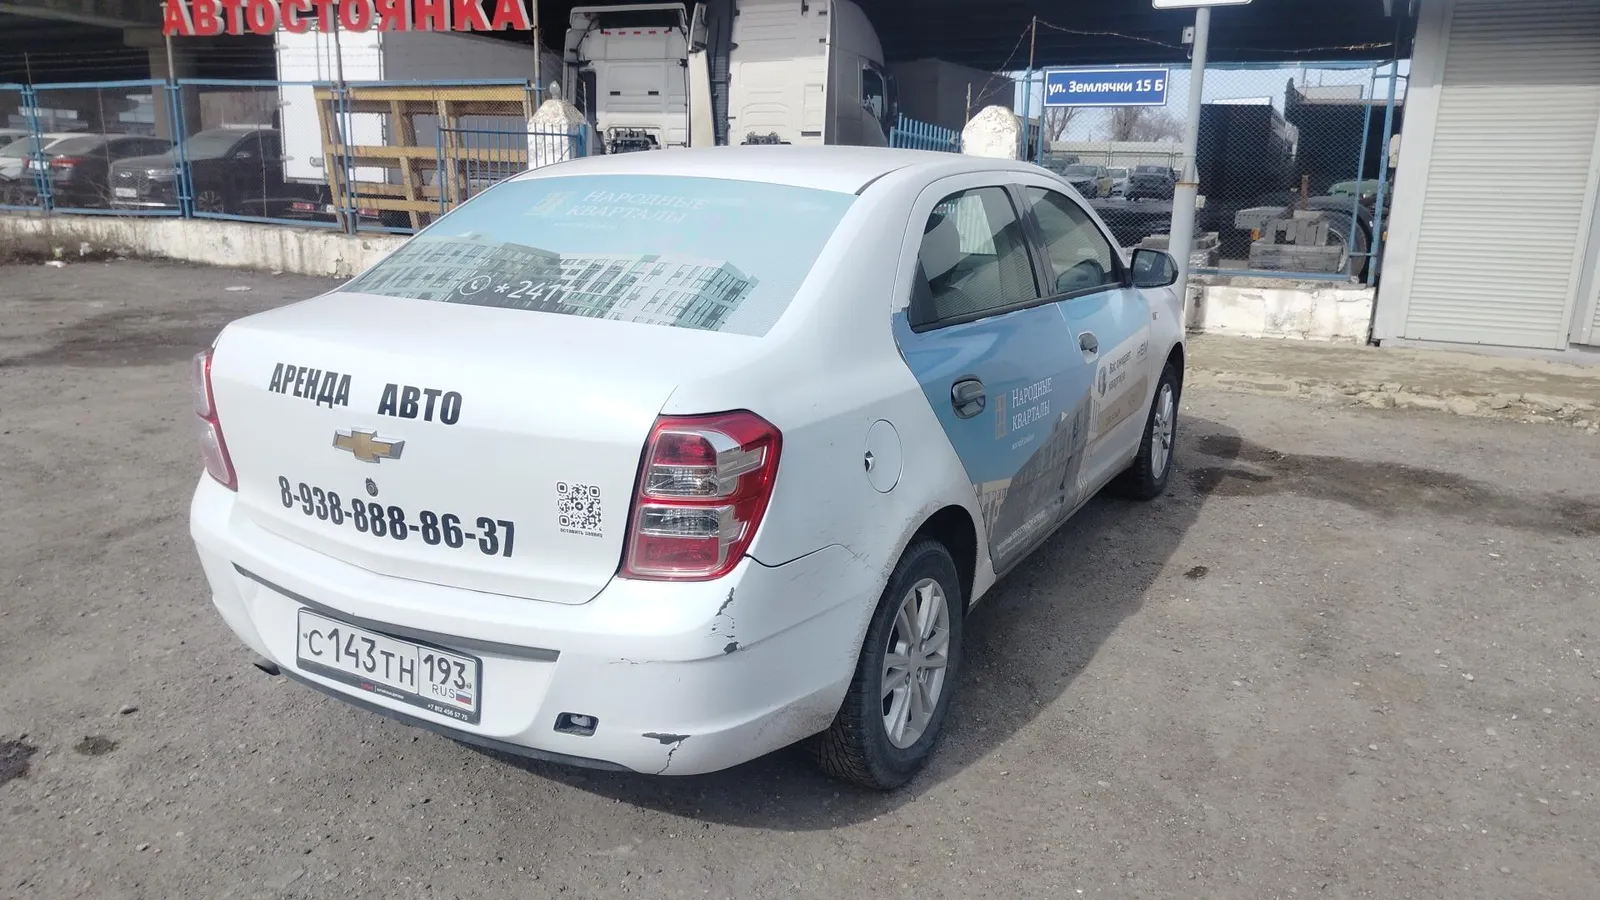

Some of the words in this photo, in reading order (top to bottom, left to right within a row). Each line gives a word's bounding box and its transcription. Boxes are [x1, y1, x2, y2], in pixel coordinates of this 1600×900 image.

[163, 0, 532, 36] АВТОСТОЯНКА
[1048, 83, 1066, 96] ул.
[1068, 80, 1133, 93] Землячки
[1135, 79, 1152, 92] 15
[1154, 79, 1164, 91] Б
[565, 205, 688, 223] КВАРТАЛЫ
[582, 190, 710, 210] НАРОДНЫЕ
[268, 363, 352, 409] АРЕНДА
[377, 383, 463, 426] АВТО
[278, 475, 515, 558] 8-938-888-86-37
[423, 654, 466, 690] 193
[431, 683, 456, 699] RUS
